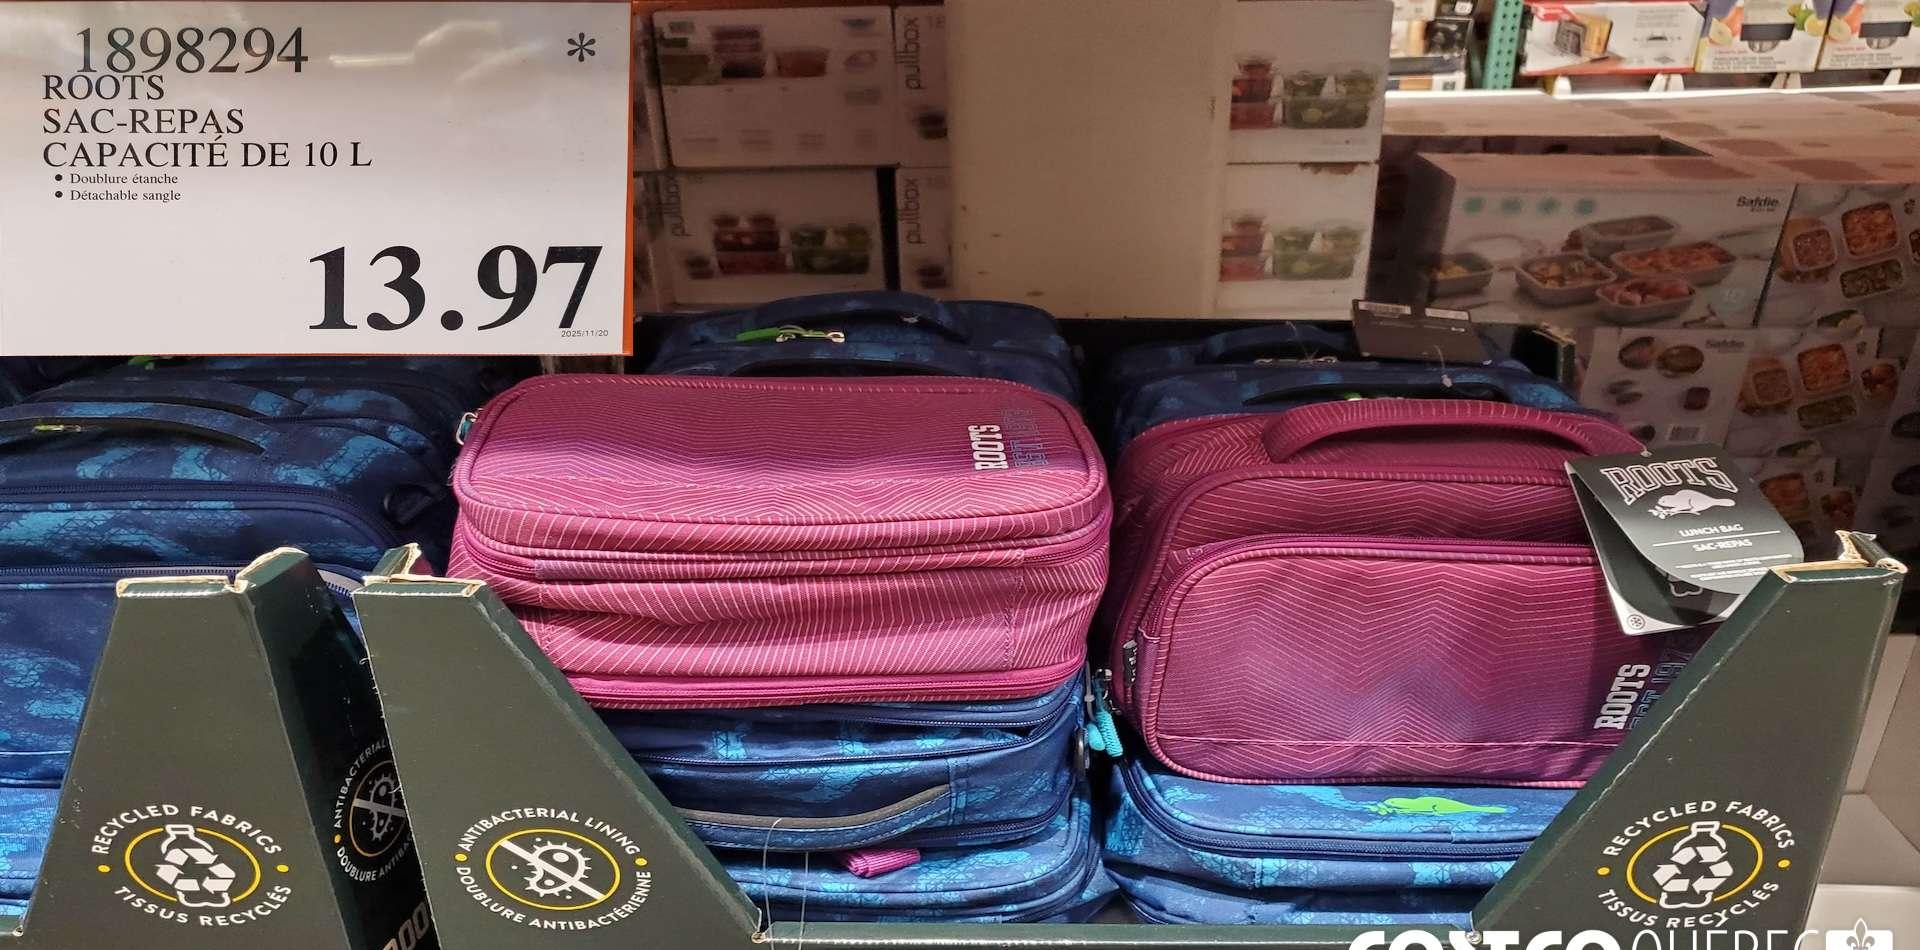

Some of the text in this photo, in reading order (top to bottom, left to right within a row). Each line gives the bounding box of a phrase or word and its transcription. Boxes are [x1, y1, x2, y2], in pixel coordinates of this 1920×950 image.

[76, 26, 309, 74] 1898294
[43, 75, 165, 101] ROOTS
[43, 109, 244, 134] SAC-REPAS
[43, 135, 373, 168] CAPACITÉ DE 10 L
[70, 173, 178, 184] Doublure étanche
[70, 188, 181, 203] Détachable sangle
[1736, 195, 1779, 208] Safdie
[309, 244, 603, 331] 13.97
[561, 329, 609, 337] 2025/11/20
[968, 424, 1009, 470] ROOTS
[1600, 457, 1739, 505] ROOTS
[1678, 523, 1744, 538] LUNCH BAG
[1692, 538, 1753, 552] SAC-REPAS
[1593, 664, 1651, 730] ROOTS
[333, 737, 388, 829] ANTIBACTERIAL
[91, 804, 282, 855] RECYCLED FABRICS
[457, 806, 641, 856] ANTIBACTERIAL LINING
[1602, 800, 1796, 857] RECYCLED FABRICS
[336, 846, 377, 882] DOUBLURE
[114, 884, 292, 927] TISSUS RECYCLÉS
[456, 866, 653, 931] DOUBLURE ANTIBACTÉRIENNE
[1597, 880, 1780, 928] TISSUS RECYCLÉS
